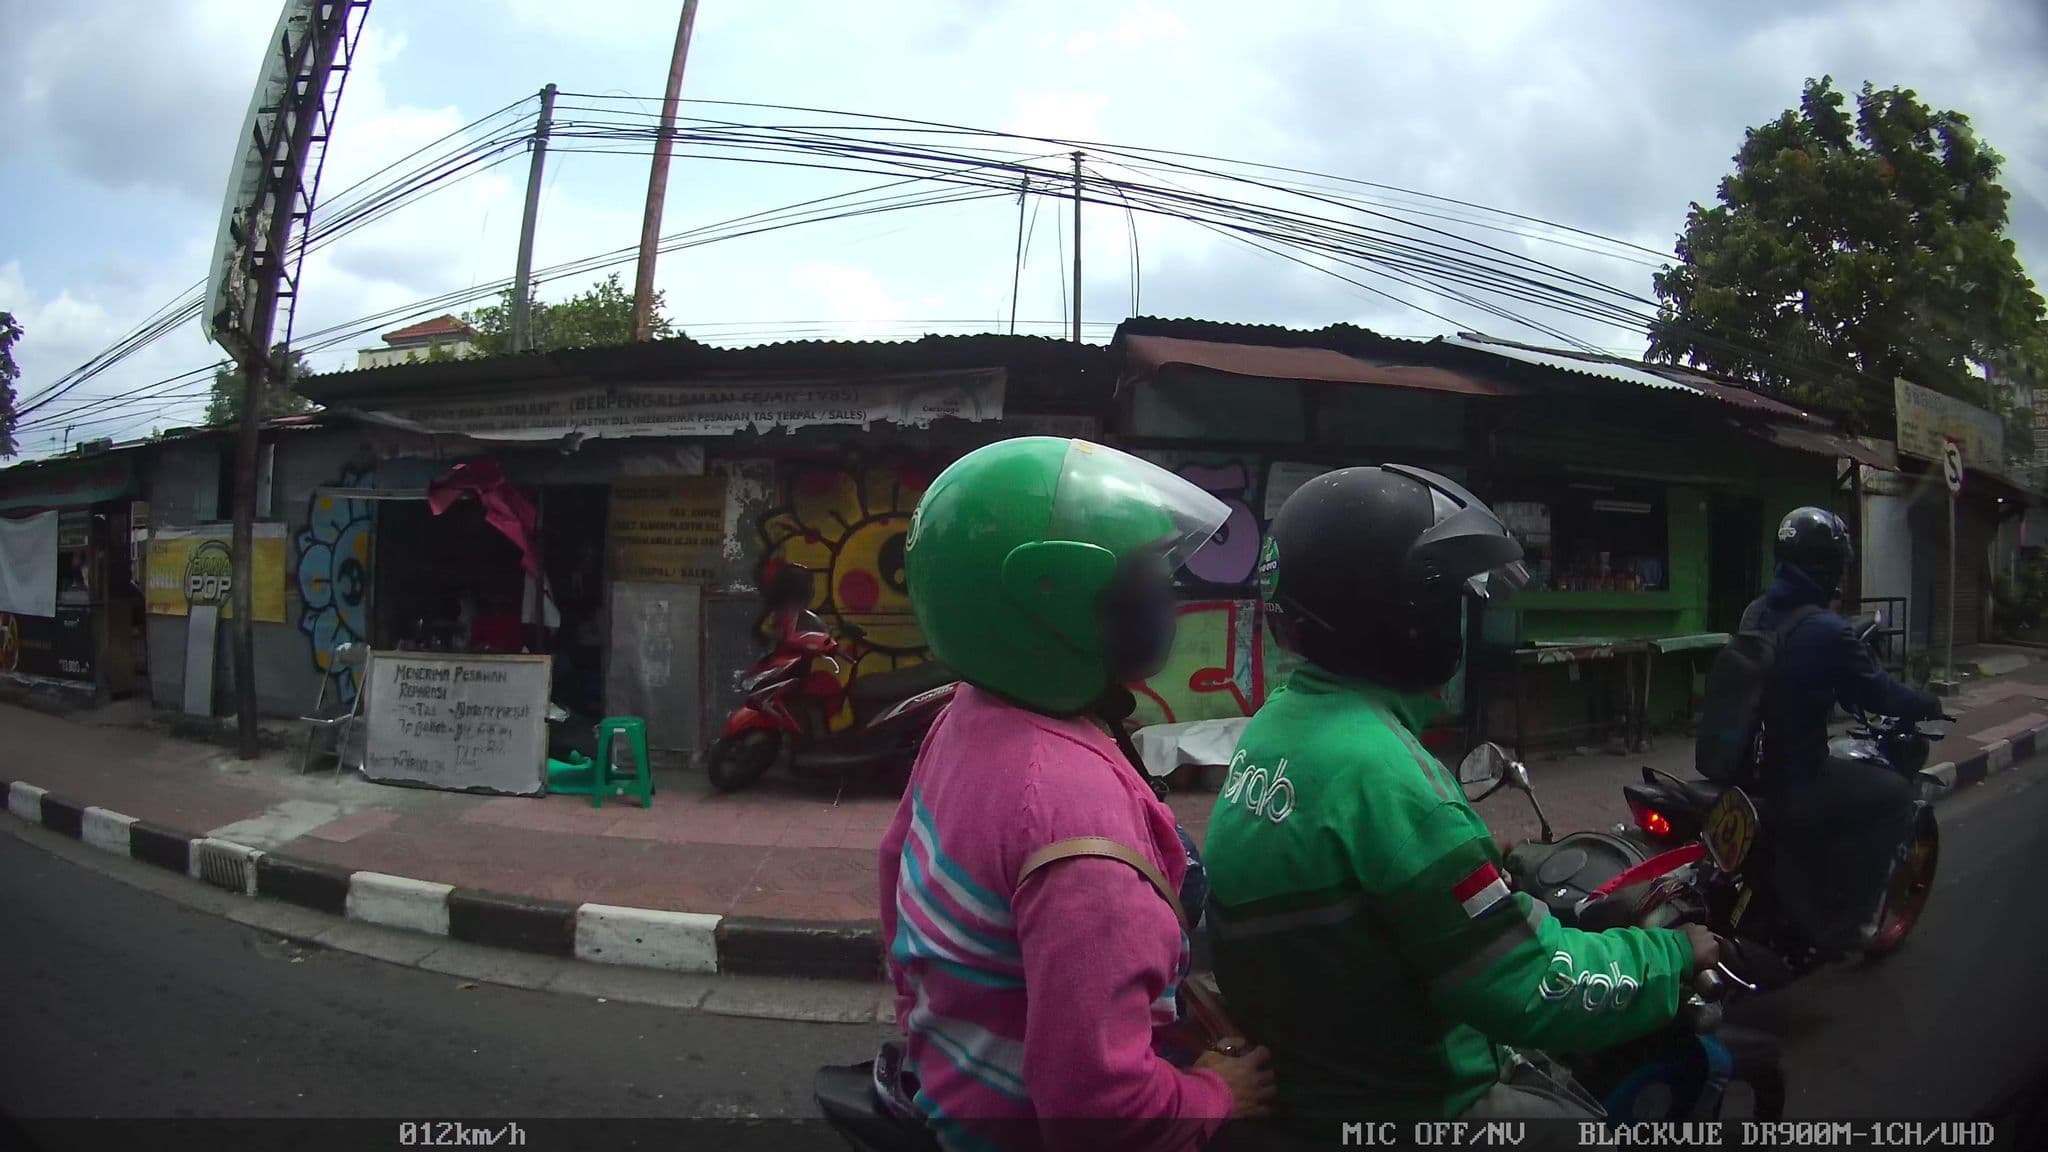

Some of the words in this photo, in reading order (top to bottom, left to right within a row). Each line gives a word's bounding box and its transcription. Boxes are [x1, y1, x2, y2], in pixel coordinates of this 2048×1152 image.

[697, 411, 750, 423] PESANAN
[754, 409, 774, 421] TAS
[777, 408, 817, 421] TERPAL
[828, 408, 868, 421] SALES)
[187, 575, 232, 600] POP
[1224, 749, 1295, 823] Grab
[1539, 951, 1638, 1011] Grab
